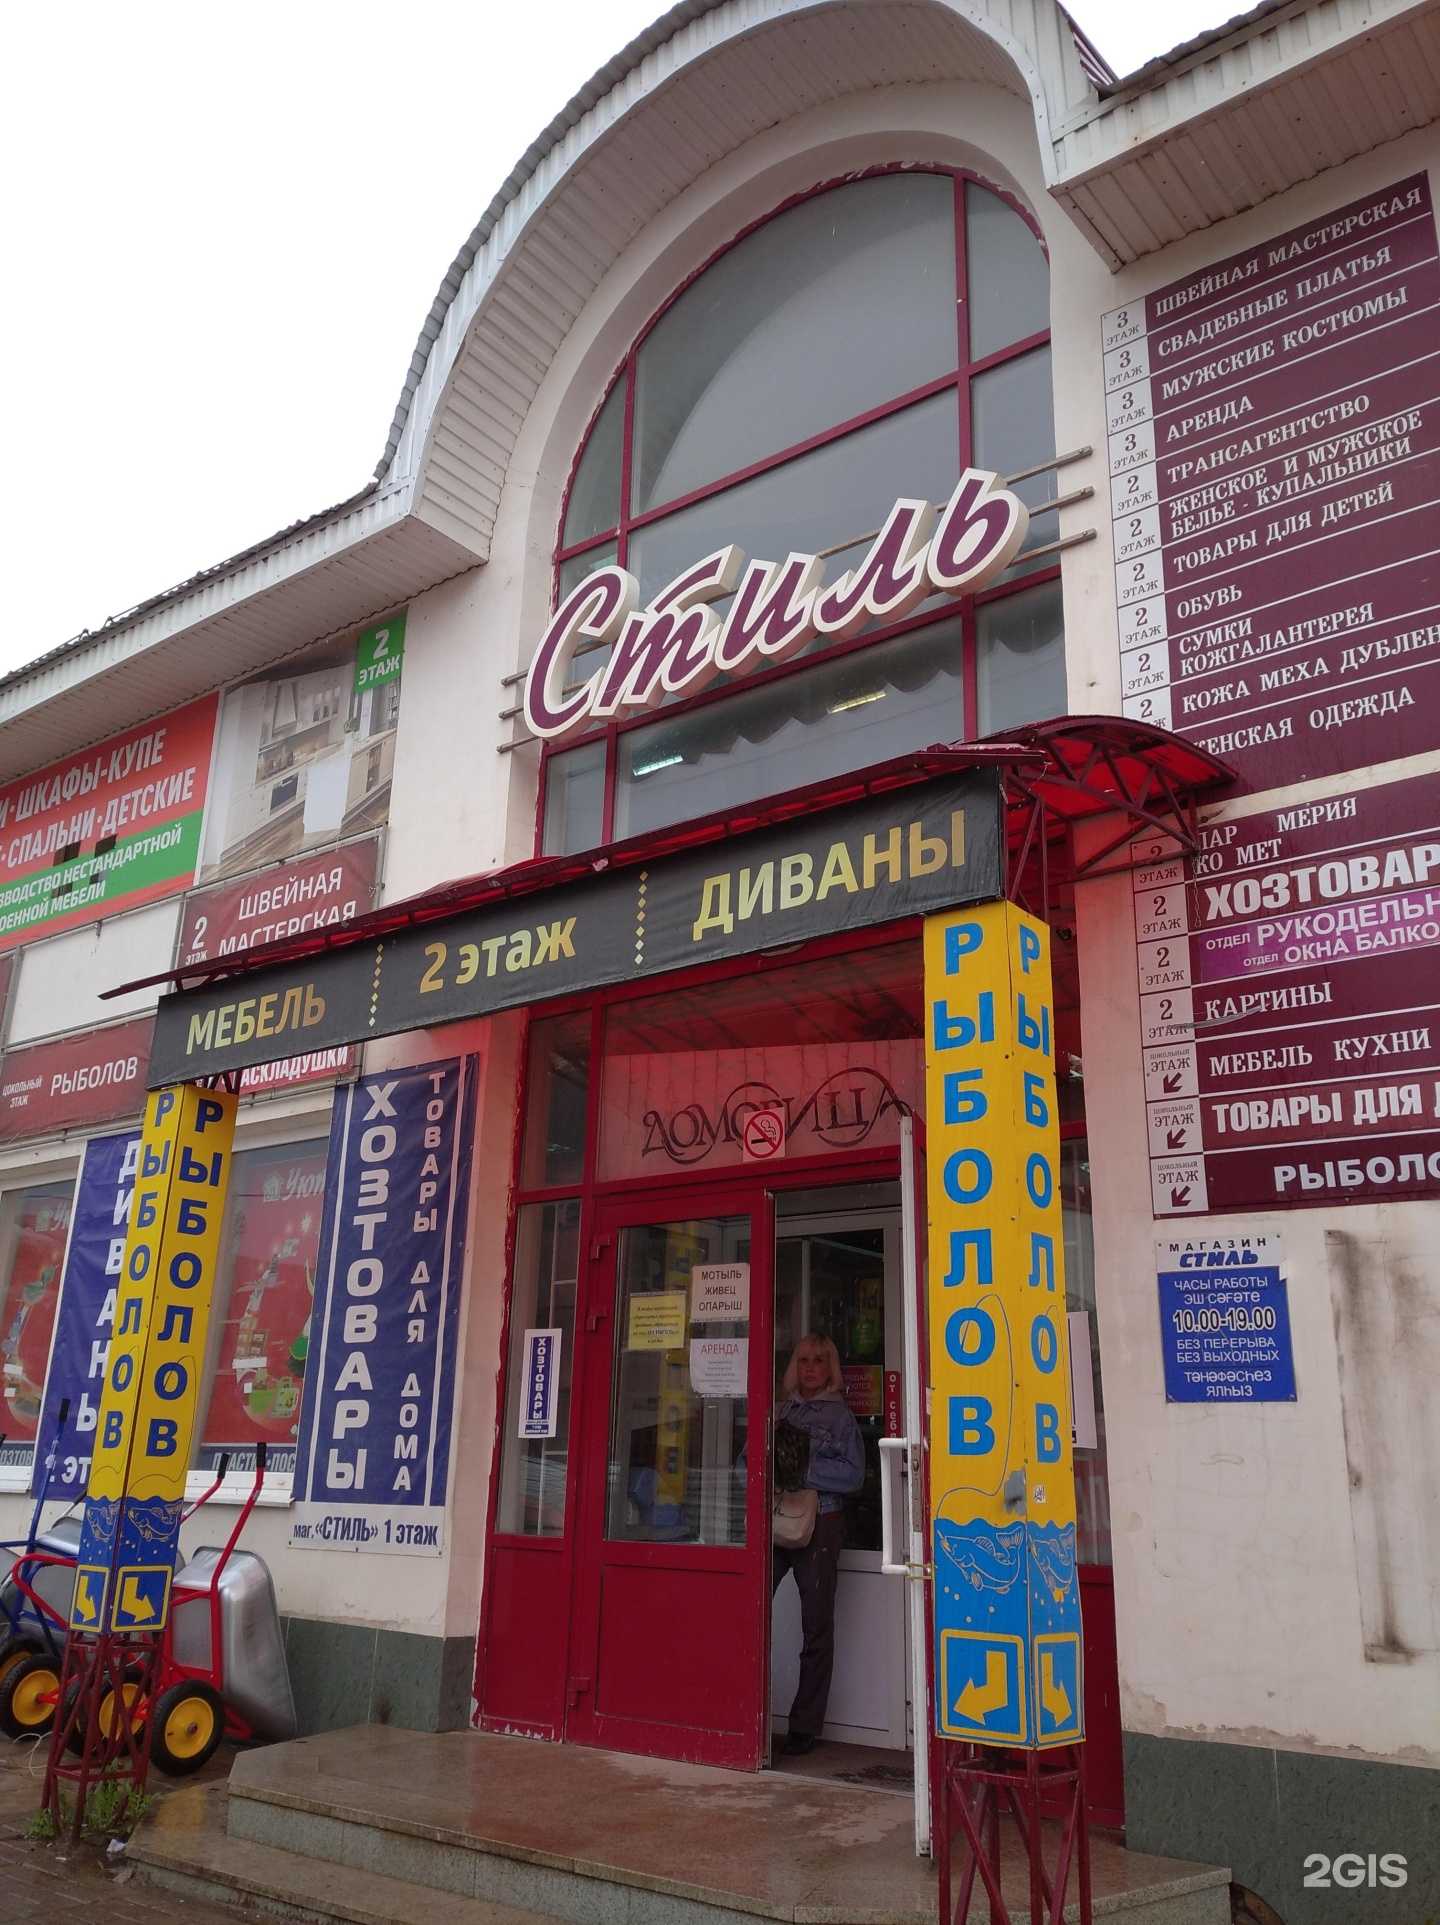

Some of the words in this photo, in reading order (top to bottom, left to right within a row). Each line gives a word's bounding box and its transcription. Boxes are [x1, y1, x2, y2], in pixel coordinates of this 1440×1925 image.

[1155, 259, 1259, 318] ШВЕЙНАЯ
[1268, 187, 1422, 268] МАСТЕРСКАЯ
[1158, 289, 1289, 358] СВАДЕБНЫЕ
[1295, 246, 1393, 302] ПЛАТЬЯ
[1117, 310, 1129, 328] 3
[1106, 324, 1140, 346] ЭТАЖ
[1161, 339, 1276, 401] МУЖСКИЕ
[1282, 286, 1409, 351] КОСТЮМЫ
[1120, 350, 1131, 368] 3
[1108, 364, 1143, 387] ЭТАЖ
[1122, 391, 1134, 409] 3
[1111, 406, 1146, 428] ЭТАЖ
[1166, 395, 1255, 443] АРЕНДА
[1125, 433, 1137, 451] 3
[1167, 393, 1370, 485] ТРАНСАГЕНТСТВО
[1113, 449, 1148, 470] ЭТАЖ
[1168, 467, 1268, 520] ЖЕНСКОЕ
[1283, 457, 1300, 476] И
[1307, 410, 1423, 468] МУЖСКОЕ
[1127, 475, 1139, 493] 2
[1171, 500, 1236, 540] БЕЛЬЕ
[1256, 436, 1413, 508] КУПАЛЬНИКИ
[1117, 490, 1153, 512] ЭТАЖ
[1130, 518, 1142, 537] 2
[1173, 530, 1258, 574] ТОВАРЫ
[1265, 510, 1313, 547] ДЛЯ
[1320, 480, 1395, 527] ДЕТЕЙ
[1120, 533, 1156, 555] ЭТАЖ
[1133, 562, 1146, 581] 2
[524, 467, 1030, 739] Стиль
[1122, 578, 1158, 600] ЭТАЖ
[1177, 585, 1243, 620] ОБУВЬ
[1135, 607, 1148, 626] 2
[375, 629, 389, 660] 2
[1125, 624, 1161, 645] ЭТАЖ
[1179, 617, 1254, 655] СУМКИ
[1180, 601, 1375, 677] КОЖГАЛАНТЕРЕЯ
[358, 654, 400, 684] ЭТАЖ
[1138, 653, 1151, 672] 2
[1182, 679, 1252, 714] КОЖА
[1260, 657, 1330, 692] МЕХА
[1340, 622, 1440, 673] ДУБЛЕН
[1128, 670, 1164, 690] ЭТАЖ
[1140, 699, 1152, 718] 2
[1309, 685, 1416, 732] ОДЕЖДА
[15, 728, 168, 822] ШКАФЫ-КУПЕ
[7, 807, 96, 869] СПАЛЬНИ
[101, 767, 196, 837] ДЕТСКИЕ
[1277, 797, 1358, 833] МЕРИЯ
[64, 823, 184, 884] НЕСТАНДАРТНОЙ
[1235, 838, 1282, 866] МЕТ
[693, 809, 966, 941] ДИВАНЫ
[1139, 867, 1178, 884] ЭТАЖ
[1205, 843, 1440, 921] ХОЗТОВАР
[50, 880, 106, 915] МЕБЕЛИ
[239, 867, 343, 920] ШВЕЙНАЯ
[1153, 895, 1167, 917] 2
[192, 916, 208, 949] 2
[218, 900, 357, 957] МАСТЕРСКАЯ
[1142, 917, 1182, 935] ЭТАЖ
[420, 943, 446, 995] 2
[459, 916, 577, 988] этаж
[1156, 946, 1170, 968] 2
[1284, 941, 1350, 964] ОКНА
[1356, 922, 1440, 952] БАЛКО
[1145, 970, 1185, 986] ЭТАЖ
[1159, 999, 1173, 1020] 2
[1204, 982, 1333, 1021] КАРТИНЫ
[186, 983, 327, 1055] МЕБЕЛЬ
[1150, 1057, 1191, 1073] ЭТАЖ
[1209, 1045, 1313, 1077] МЕБЕЛЬ
[1333, 1027, 1432, 1061] КУХНИ
[50, 1056, 138, 1096] РЫБОЛОВ
[642, 1067, 912, 1165] ДОМОИЦА
[1154, 1112, 1195, 1128] ЭТАЖ
[1212, 1092, 1343, 1134] ТОВАРЫ
[1353, 1083, 1423, 1126] ДЛЯ
[413, 1072, 446, 1232] ТОВАРЫ
[932, 923, 996, 1457] РЫБОЛОВ
[1158, 1170, 1199, 1185] ЭТАЖ
[1017, 923, 1062, 1464] РЫБОЛОВ
[1169, 1238, 1266, 1252] МАГАЗИН
[1179, 1250, 1259, 1268] СТИЛЬ
[102, 1091, 175, 1449] РЫБОЛОВ
[145, 1098, 224, 1457] РЫБОЛОВ
[701, 1270, 742, 1280] МОТЫЛЬ
[1174, 1279, 1211, 1291] ЧАСЫ
[1214, 1276, 1268, 1289] РАБОТЫ
[326, 1081, 399, 1490] ХОЗТОВАРЫ
[705, 1286, 736, 1296] ЖИВЕЦ
[407, 1261, 430, 1343] ДЛЯ
[699, 1301, 742, 1312] ОПАРЫШ
[1173, 1306, 1276, 1333] 10.00-19.00
[701, 1343, 739, 1356] АРЕНДА
[1176, 1339, 1200, 1350] БЕЗ
[1204, 1337, 1276, 1349] ПЕРЕРЫВА
[1176, 1352, 1200, 1363] БЕЗ
[1204, 1350, 1280, 1363] ВЫХОДНЫХ
[533, 1338, 547, 1419] ХОЗТОВАРЫ
[392, 1374, 421, 1491] ДОМА
[0, 1448, 34, 1466] ОЗТОВ
[384, 1519, 392, 1543] 1
[396, 1523, 438, 1546] этаж
